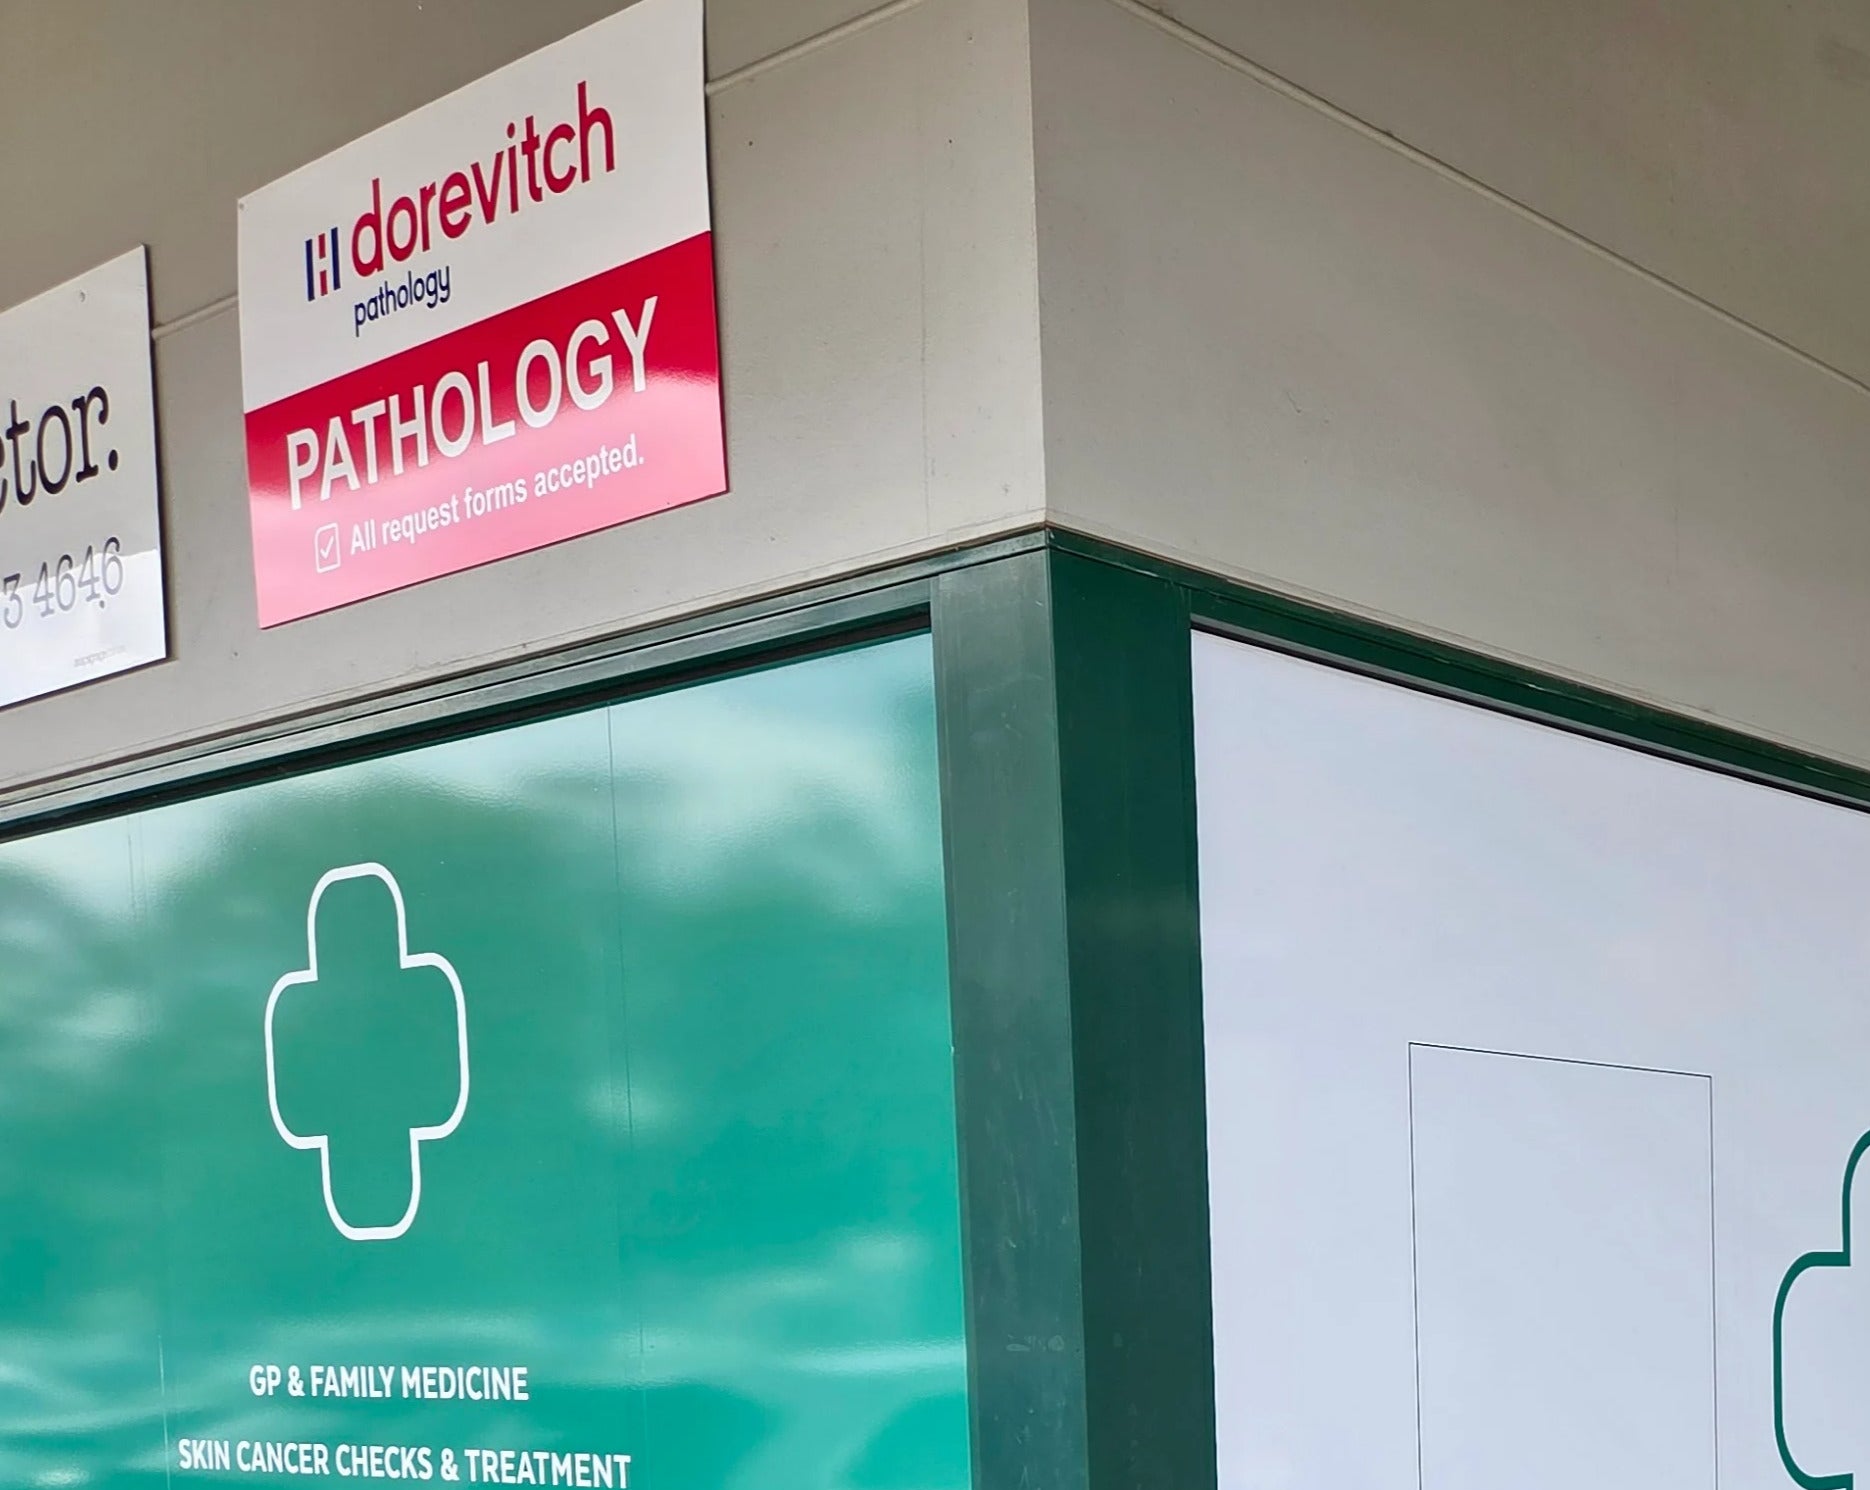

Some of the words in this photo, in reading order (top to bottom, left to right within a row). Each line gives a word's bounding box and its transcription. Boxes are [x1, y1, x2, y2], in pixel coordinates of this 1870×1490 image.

[352, 80, 615, 277] dorevitch
[354, 266, 450, 337] pathology
[0, 386, 118, 515] tor.
[286, 296, 658, 510] PATHOLOGY
[350, 519, 375, 555] All
[382, 499, 460, 544] request
[464, 478, 527, 518] forms
[534, 434, 644, 498] accepted.
[33, 537, 123, 617] 4646
[249, 1364, 281, 1396] GP
[288, 1365, 306, 1397] &
[310, 1365, 395, 1398] FAMILY
[401, 1366, 529, 1401] MEDICINE
[178, 1438, 230, 1470] SKIN
[236, 1441, 329, 1476] CANCER
[335, 1445, 433, 1480] CHECKS
[441, 1448, 459, 1481] &
[465, 1449, 631, 1489] TREATMENT
